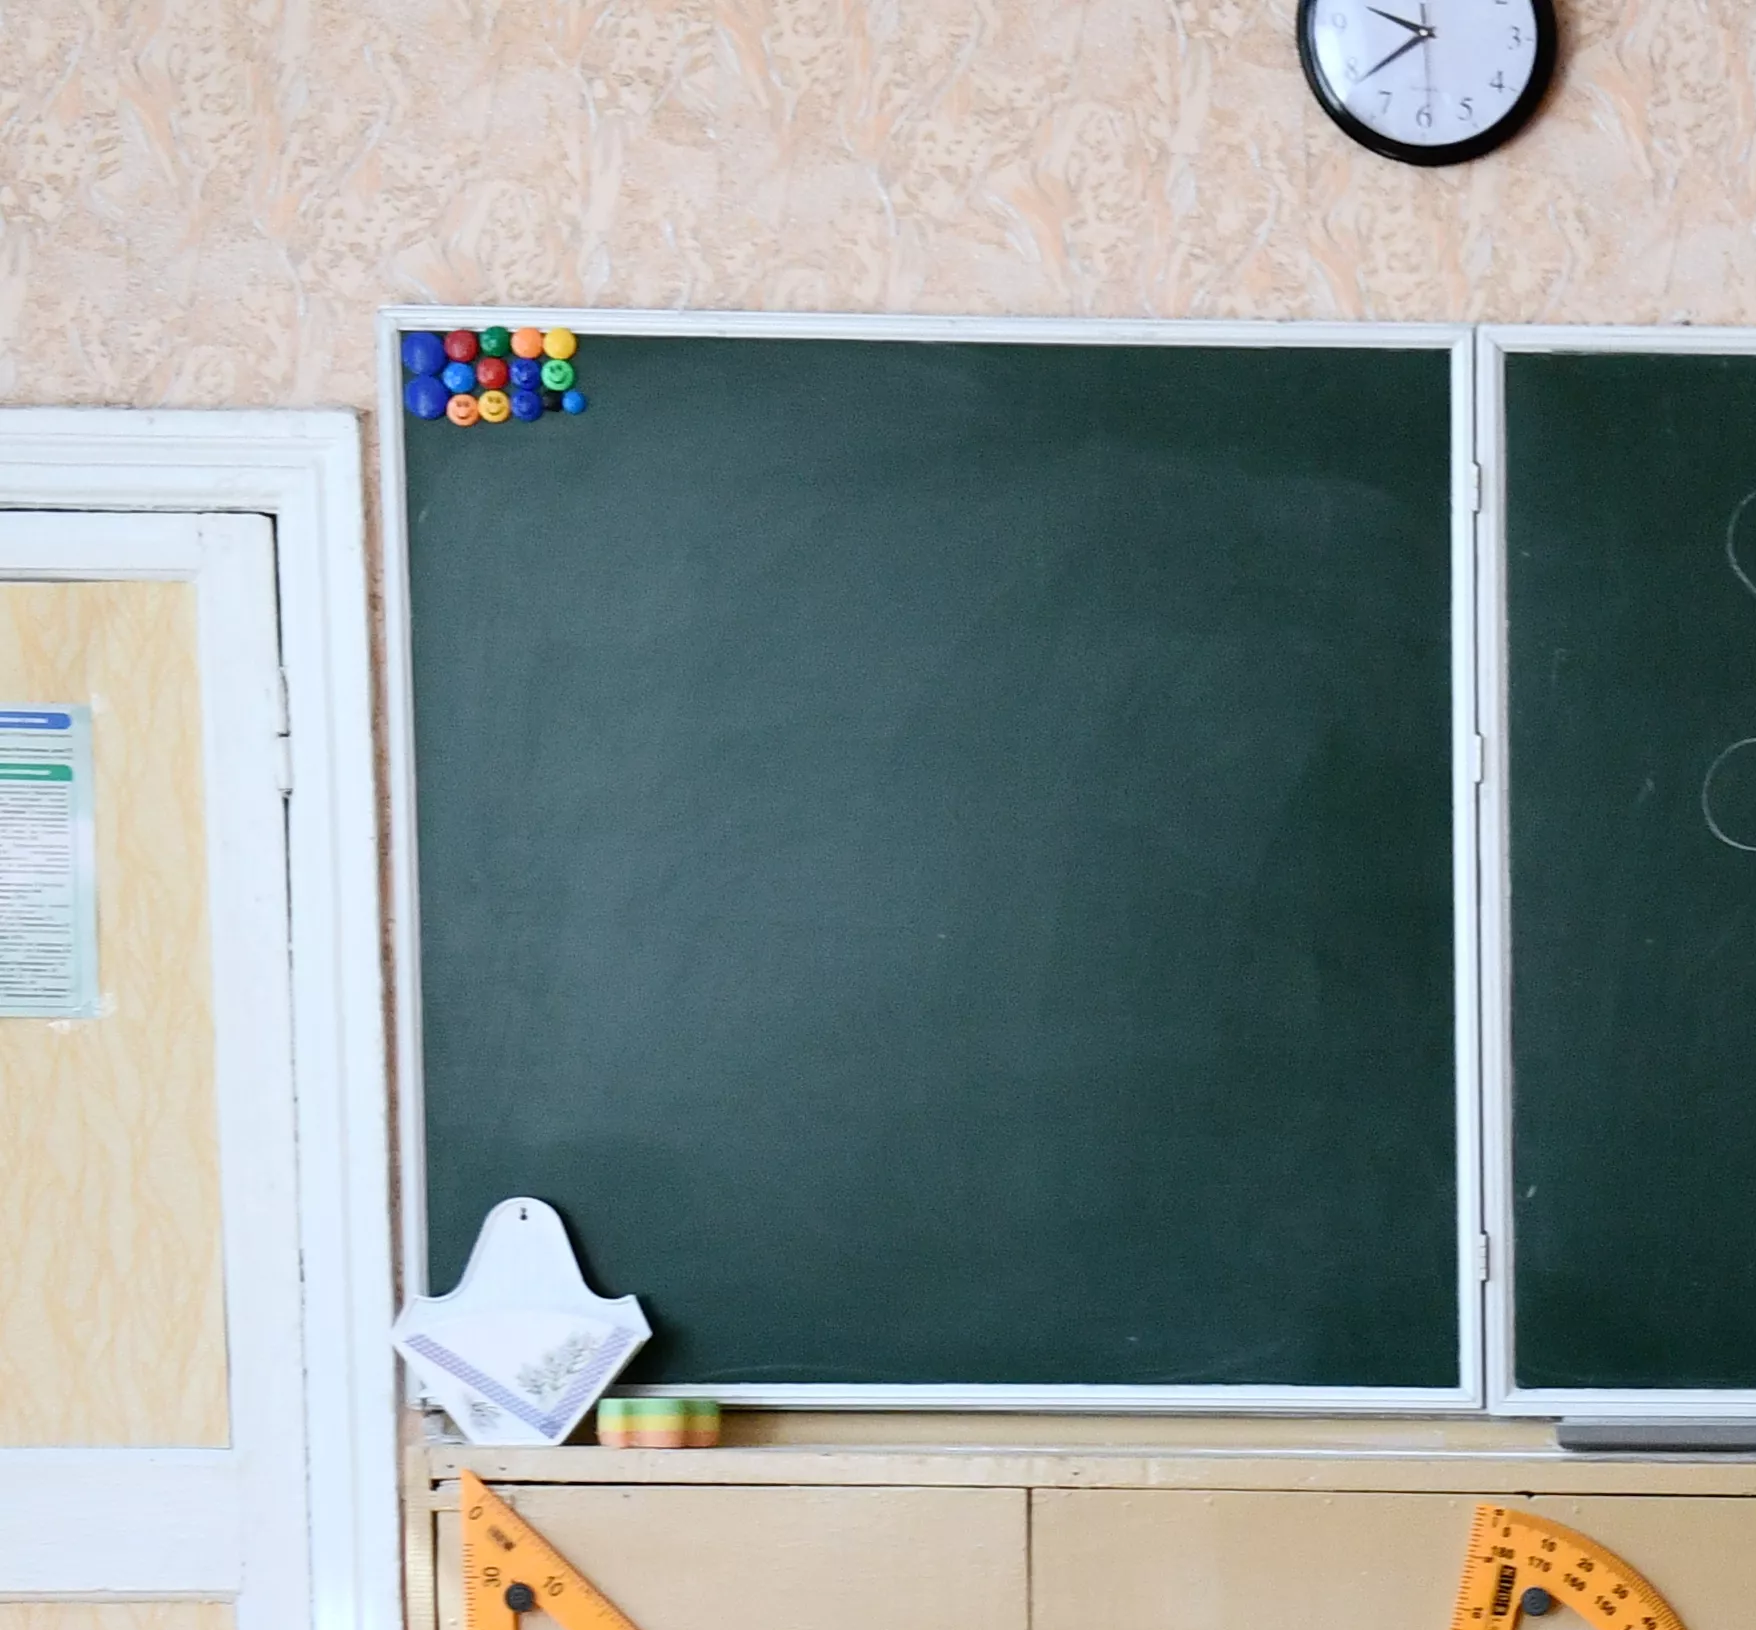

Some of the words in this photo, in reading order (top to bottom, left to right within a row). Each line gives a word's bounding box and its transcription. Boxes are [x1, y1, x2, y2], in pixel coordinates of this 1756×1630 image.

[1331, 12, 1347, 33] 9
[1508, 24, 1522, 50] 3
[1344, 57, 1361, 82] 8
[1489, 70, 1505, 93] 4
[1378, 90, 1393, 115] 7
[1458, 96, 1474, 121] 5
[1415, 104, 1433, 129] 6
[467, 1505, 484, 1521] 0
[542, 1574, 565, 1598] 10
[483, 1566, 501, 1588] 30
